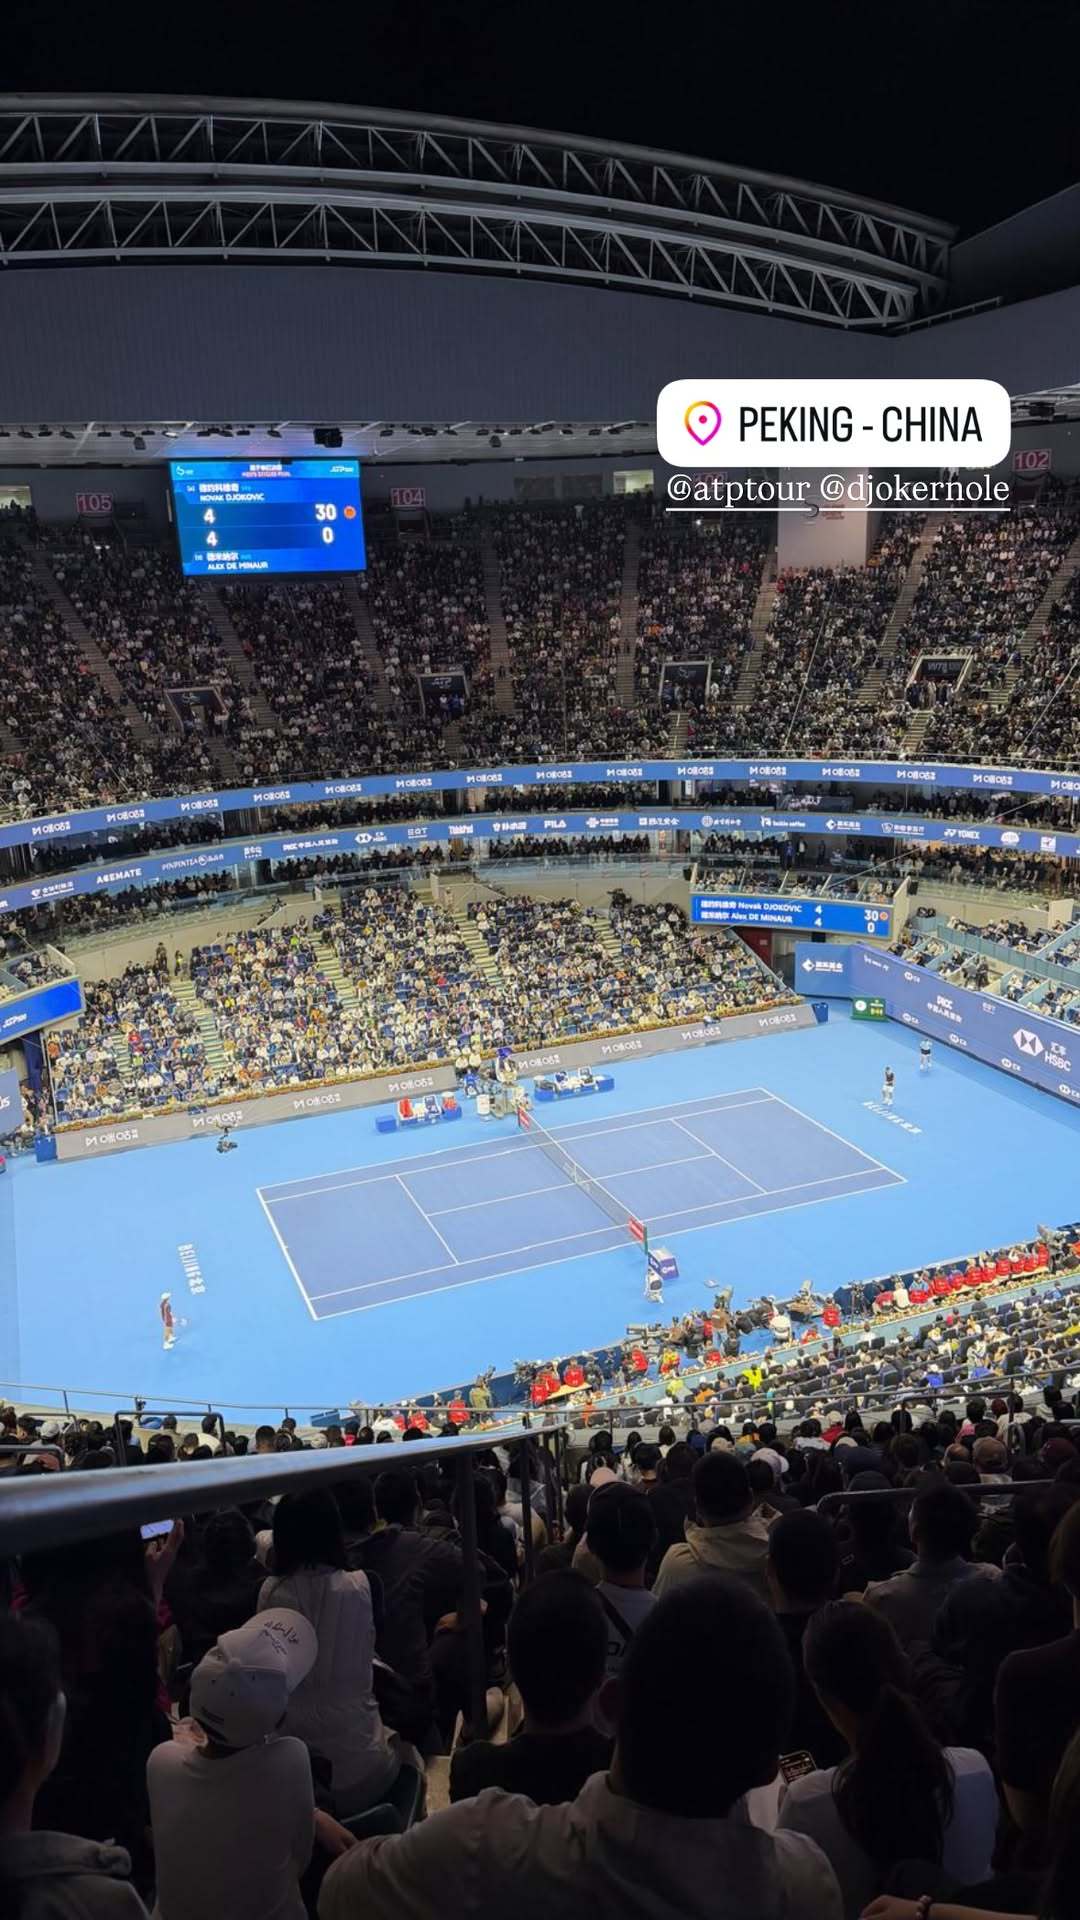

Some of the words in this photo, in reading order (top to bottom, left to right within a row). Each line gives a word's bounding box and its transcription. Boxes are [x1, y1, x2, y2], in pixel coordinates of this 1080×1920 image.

[1014, 452, 1050, 469] 102
[78, 495, 112, 511] 105
[200, 494, 224, 502] NOVAK
[225, 493, 265, 501] DJOKOVIC
[393, 489, 423, 505] 104
[203, 508, 216, 524] 4
[314, 503, 337, 521] 30
[206, 531, 218, 546] 4
[321, 527, 334, 544] 0
[226, 562, 238, 570] DE
[239, 561, 269, 569] MINAUR
[544, 819, 567, 829] FILA
[958, 830, 980, 840] YONEX
[738, 901, 762, 910] Novak
[763, 903, 802, 912] DJOKOVIC
[814, 904, 823, 914] 4
[864, 909, 879, 922] 30
[731, 912, 747, 920] Alex
[760, 914, 793, 923] MINAUR
[814, 917, 823, 927] 4
[867, 921, 876, 933] 0
[1044, 1051, 1072, 1072] HSBC
